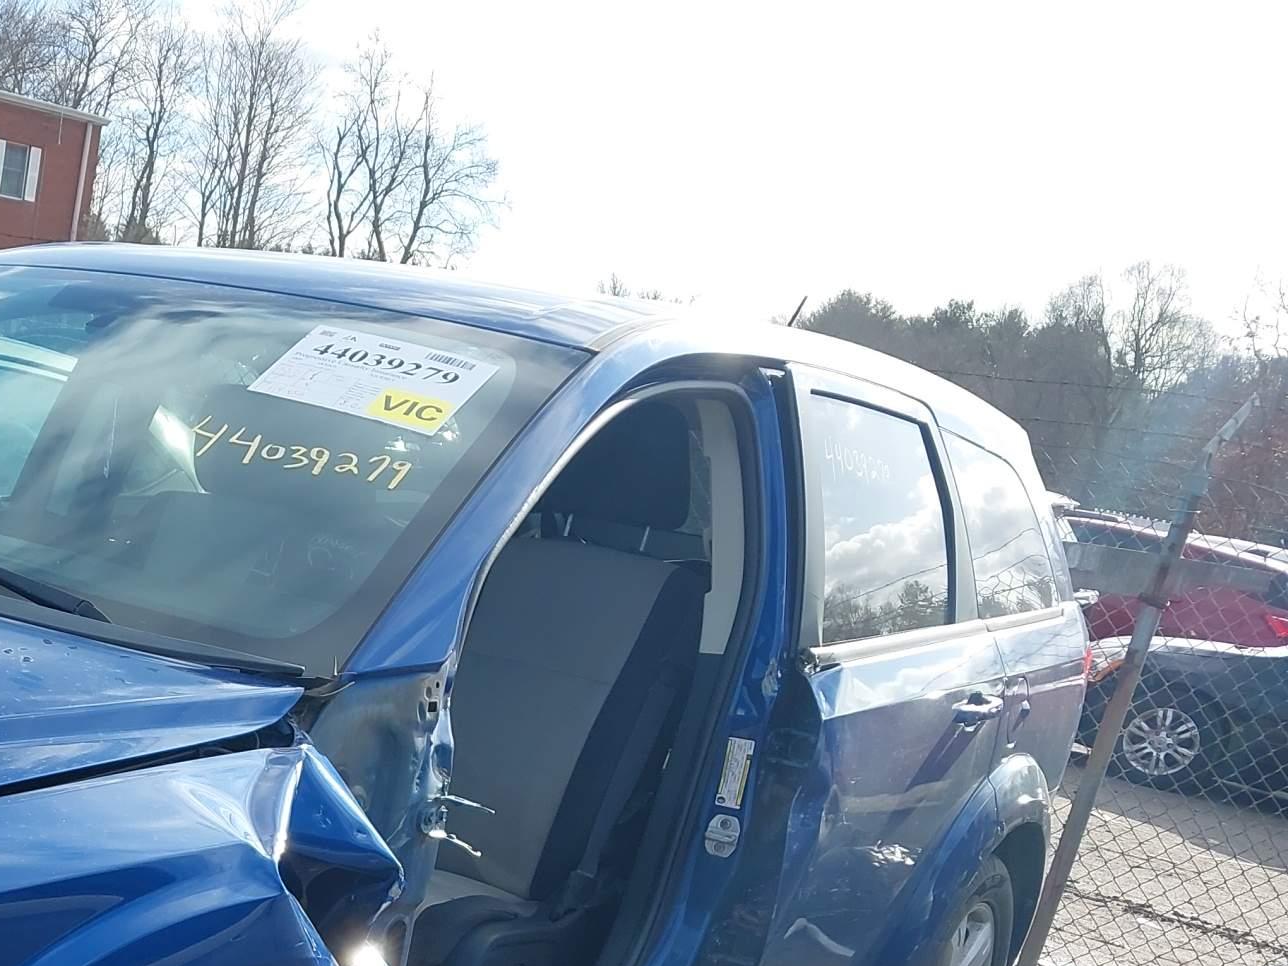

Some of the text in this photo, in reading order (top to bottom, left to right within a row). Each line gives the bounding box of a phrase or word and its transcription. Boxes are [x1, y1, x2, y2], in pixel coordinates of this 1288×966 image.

[313, 342, 460, 385] 44039279
[382, 394, 444, 422] VIC
[192, 416, 412, 489] 44039279
